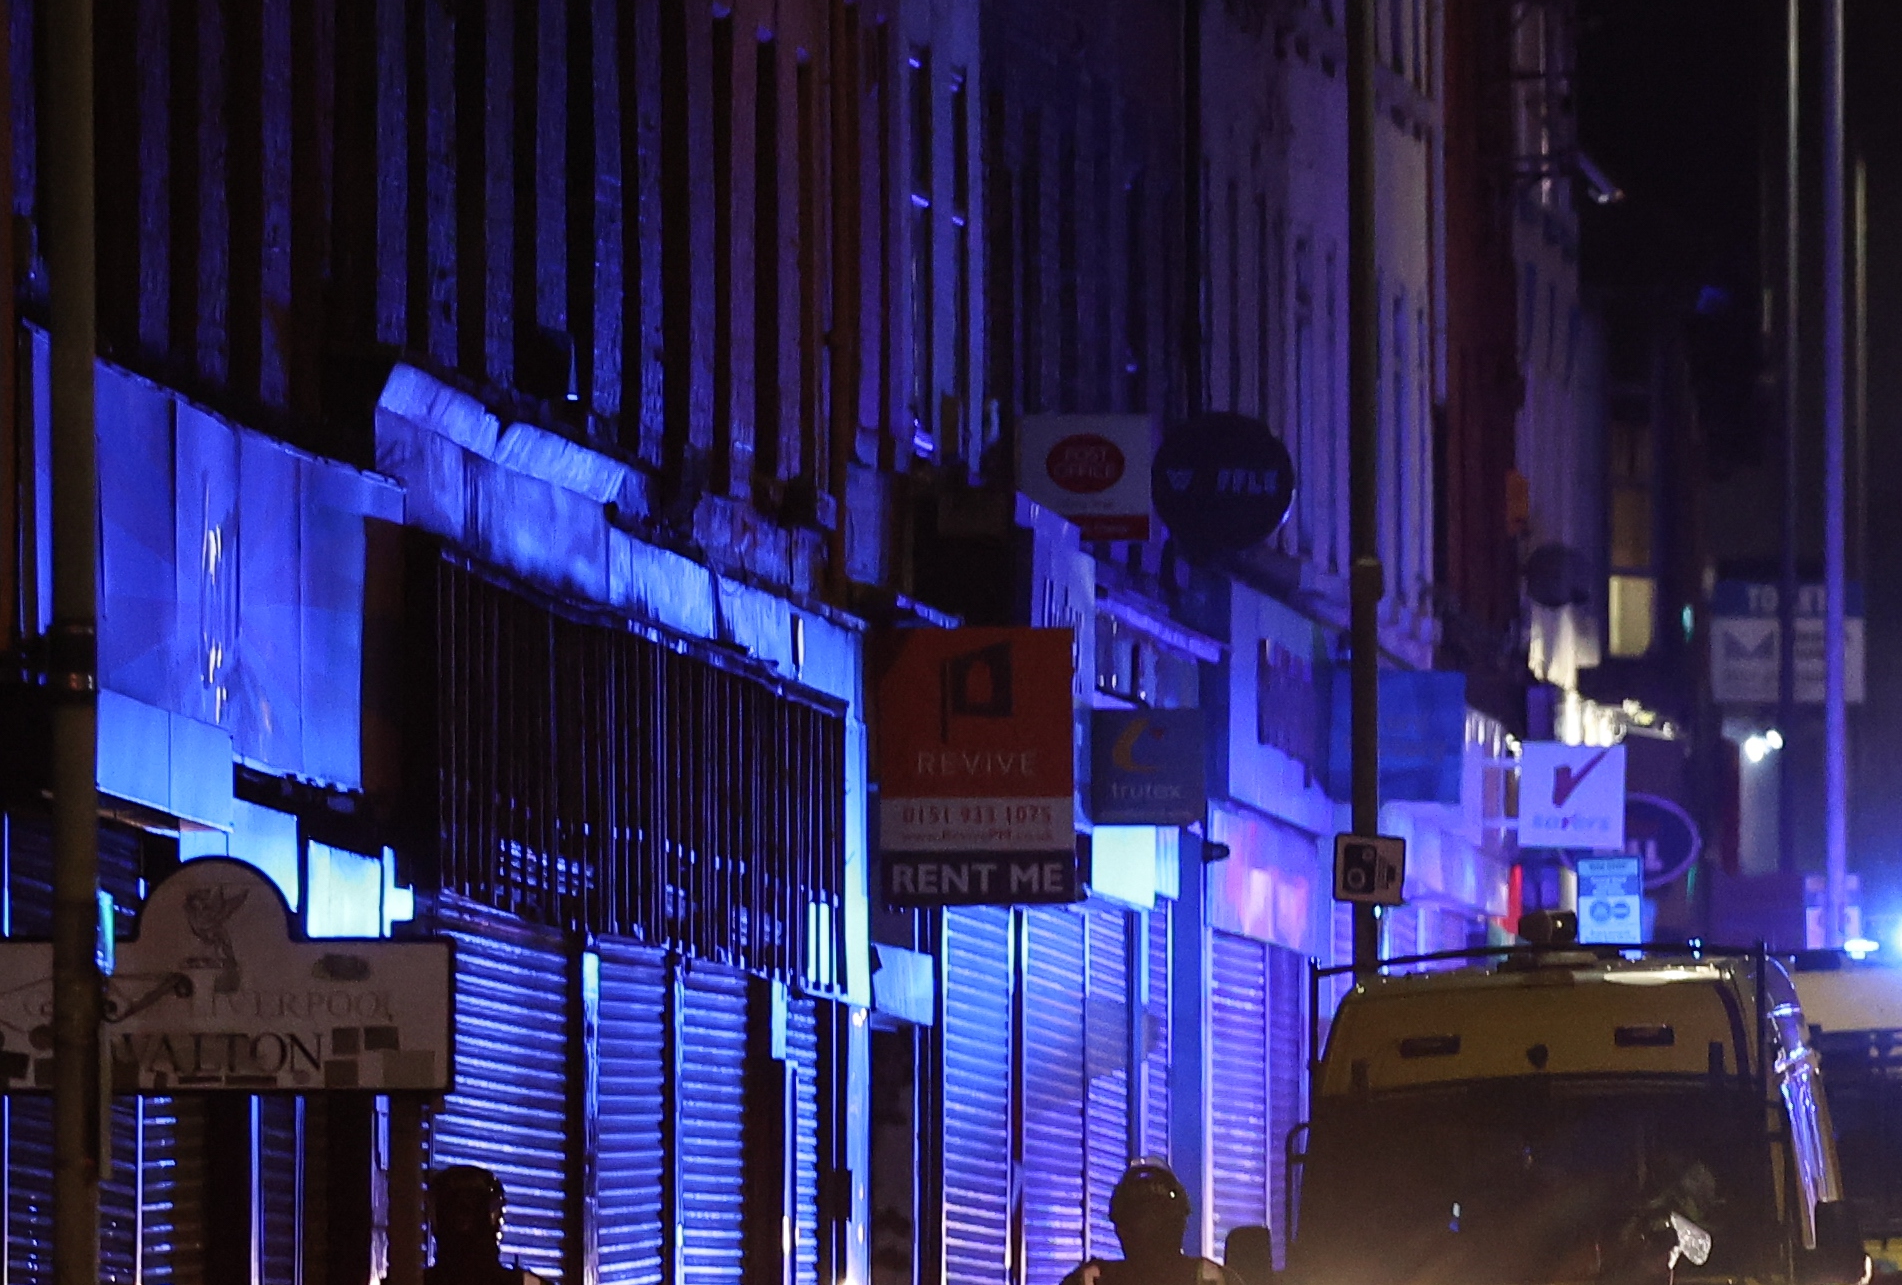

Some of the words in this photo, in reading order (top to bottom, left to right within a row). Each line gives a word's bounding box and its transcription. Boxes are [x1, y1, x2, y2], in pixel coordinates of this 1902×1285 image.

[917, 749, 1036, 776] REVIVE
[1111, 780, 1182, 800] trutex
[902, 805, 949, 825] 0151
[891, 862, 999, 895] RENT
[1010, 862, 1065, 894] ME
[111, 1031, 323, 1074] WALTON
